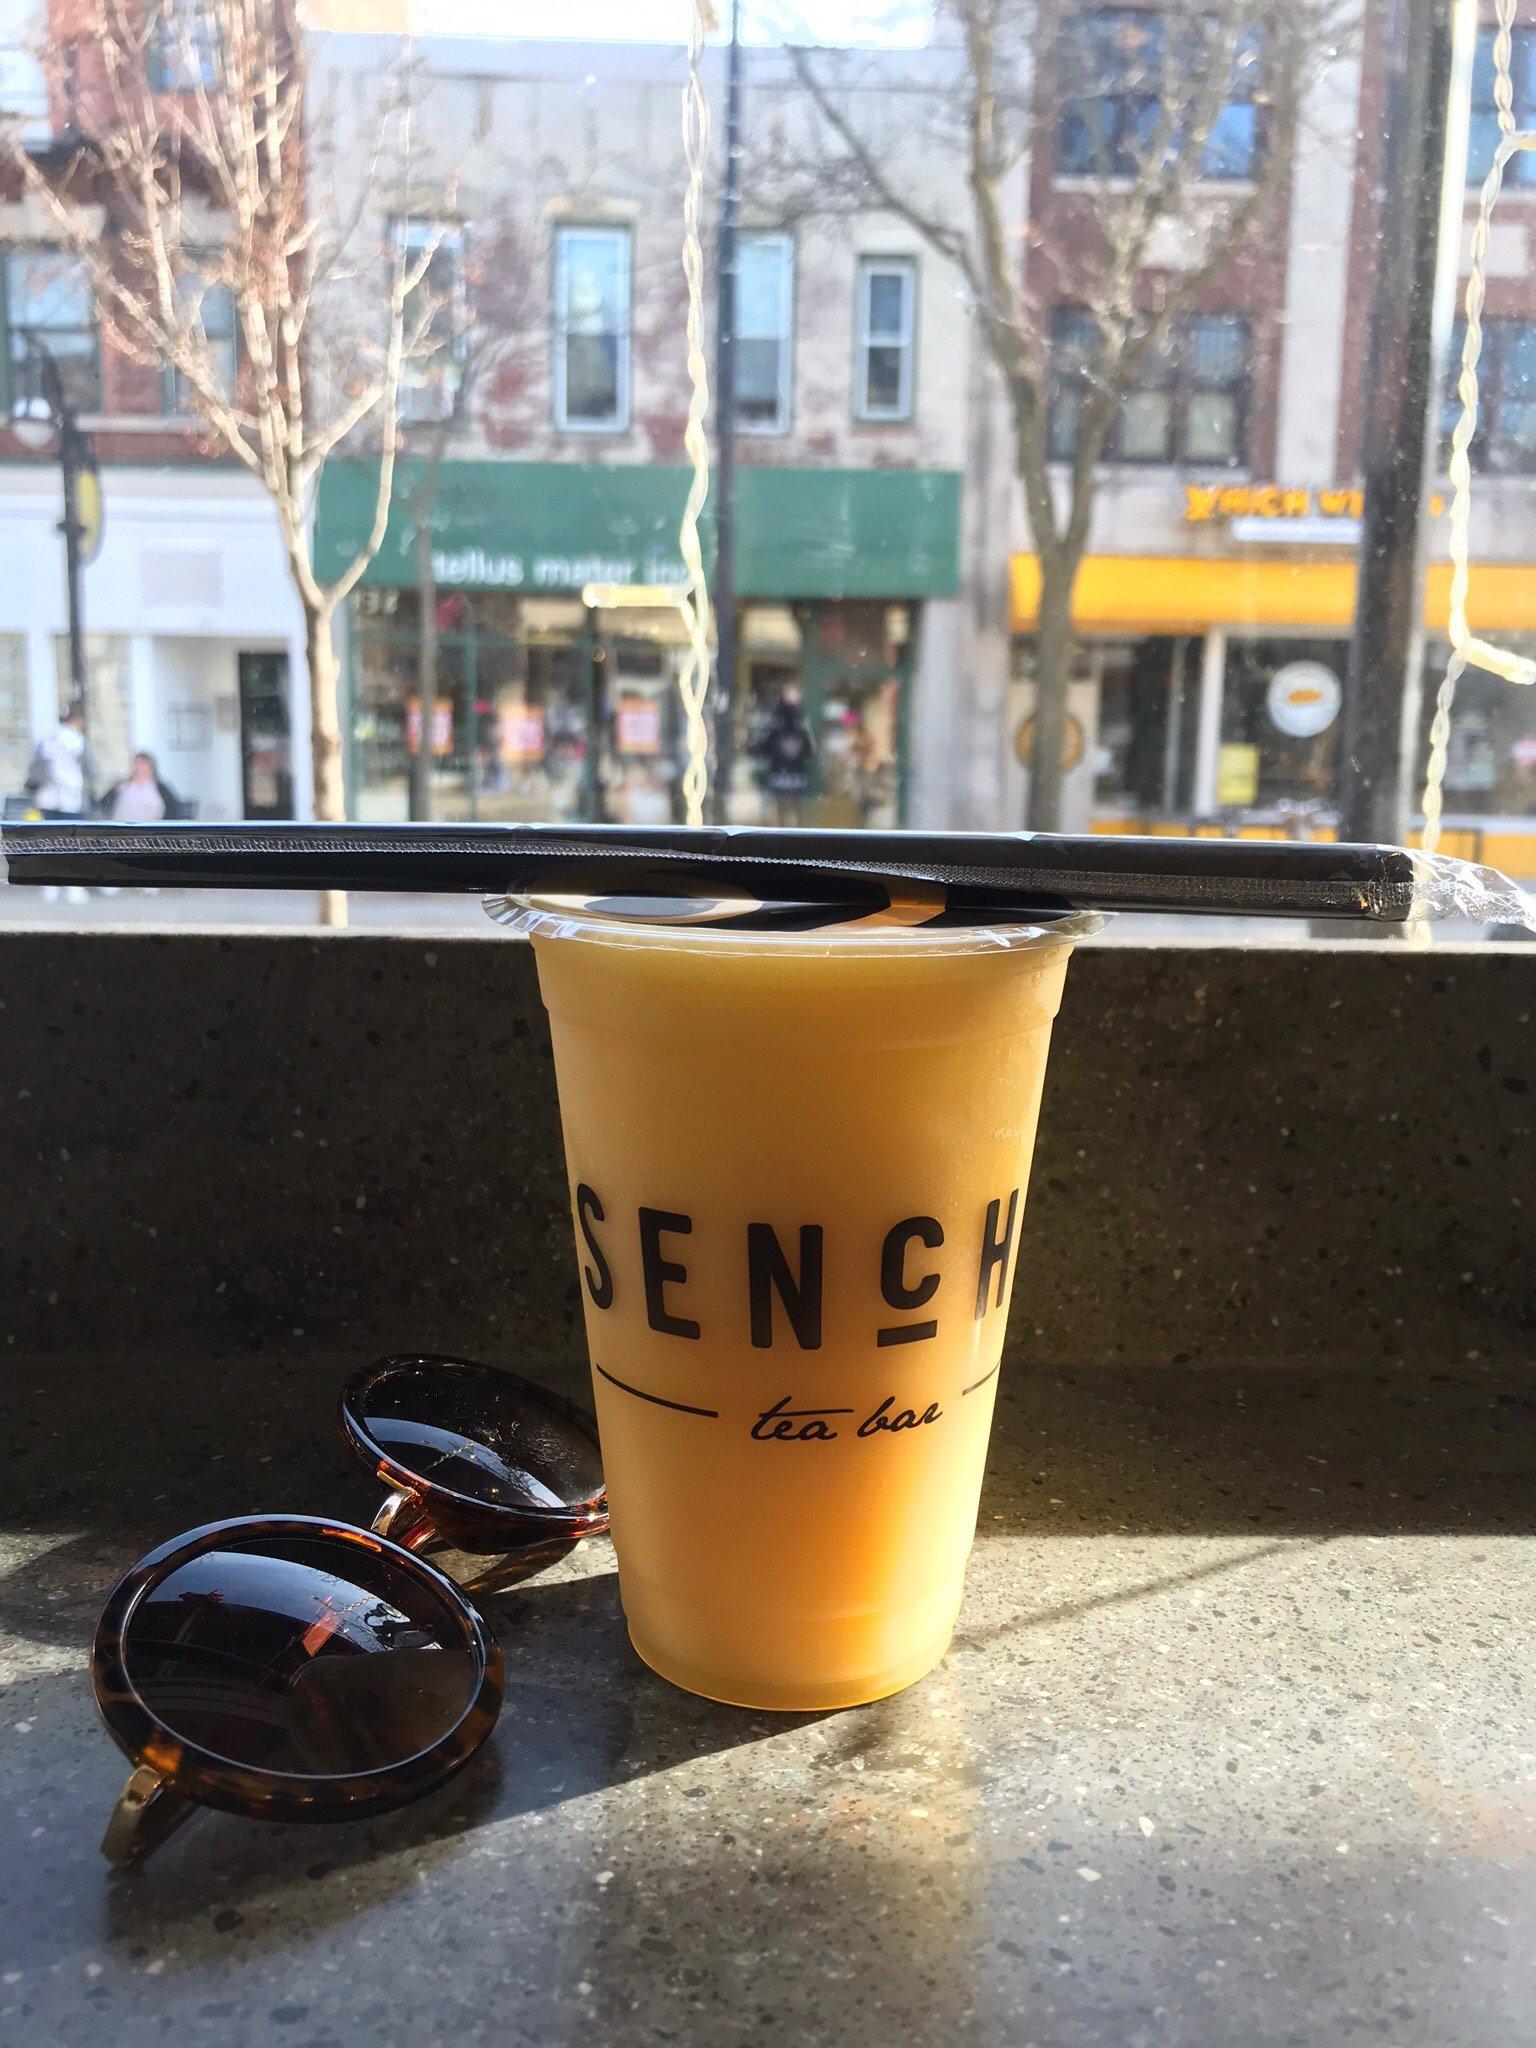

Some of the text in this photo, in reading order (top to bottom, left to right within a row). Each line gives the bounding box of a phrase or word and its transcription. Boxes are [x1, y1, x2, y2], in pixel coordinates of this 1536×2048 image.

[432, 548, 524, 586] tellus
[533, 553, 635, 586] mater
[576, 1183, 1019, 1350] SENCH
[750, 1396, 944, 1441] tea bar
